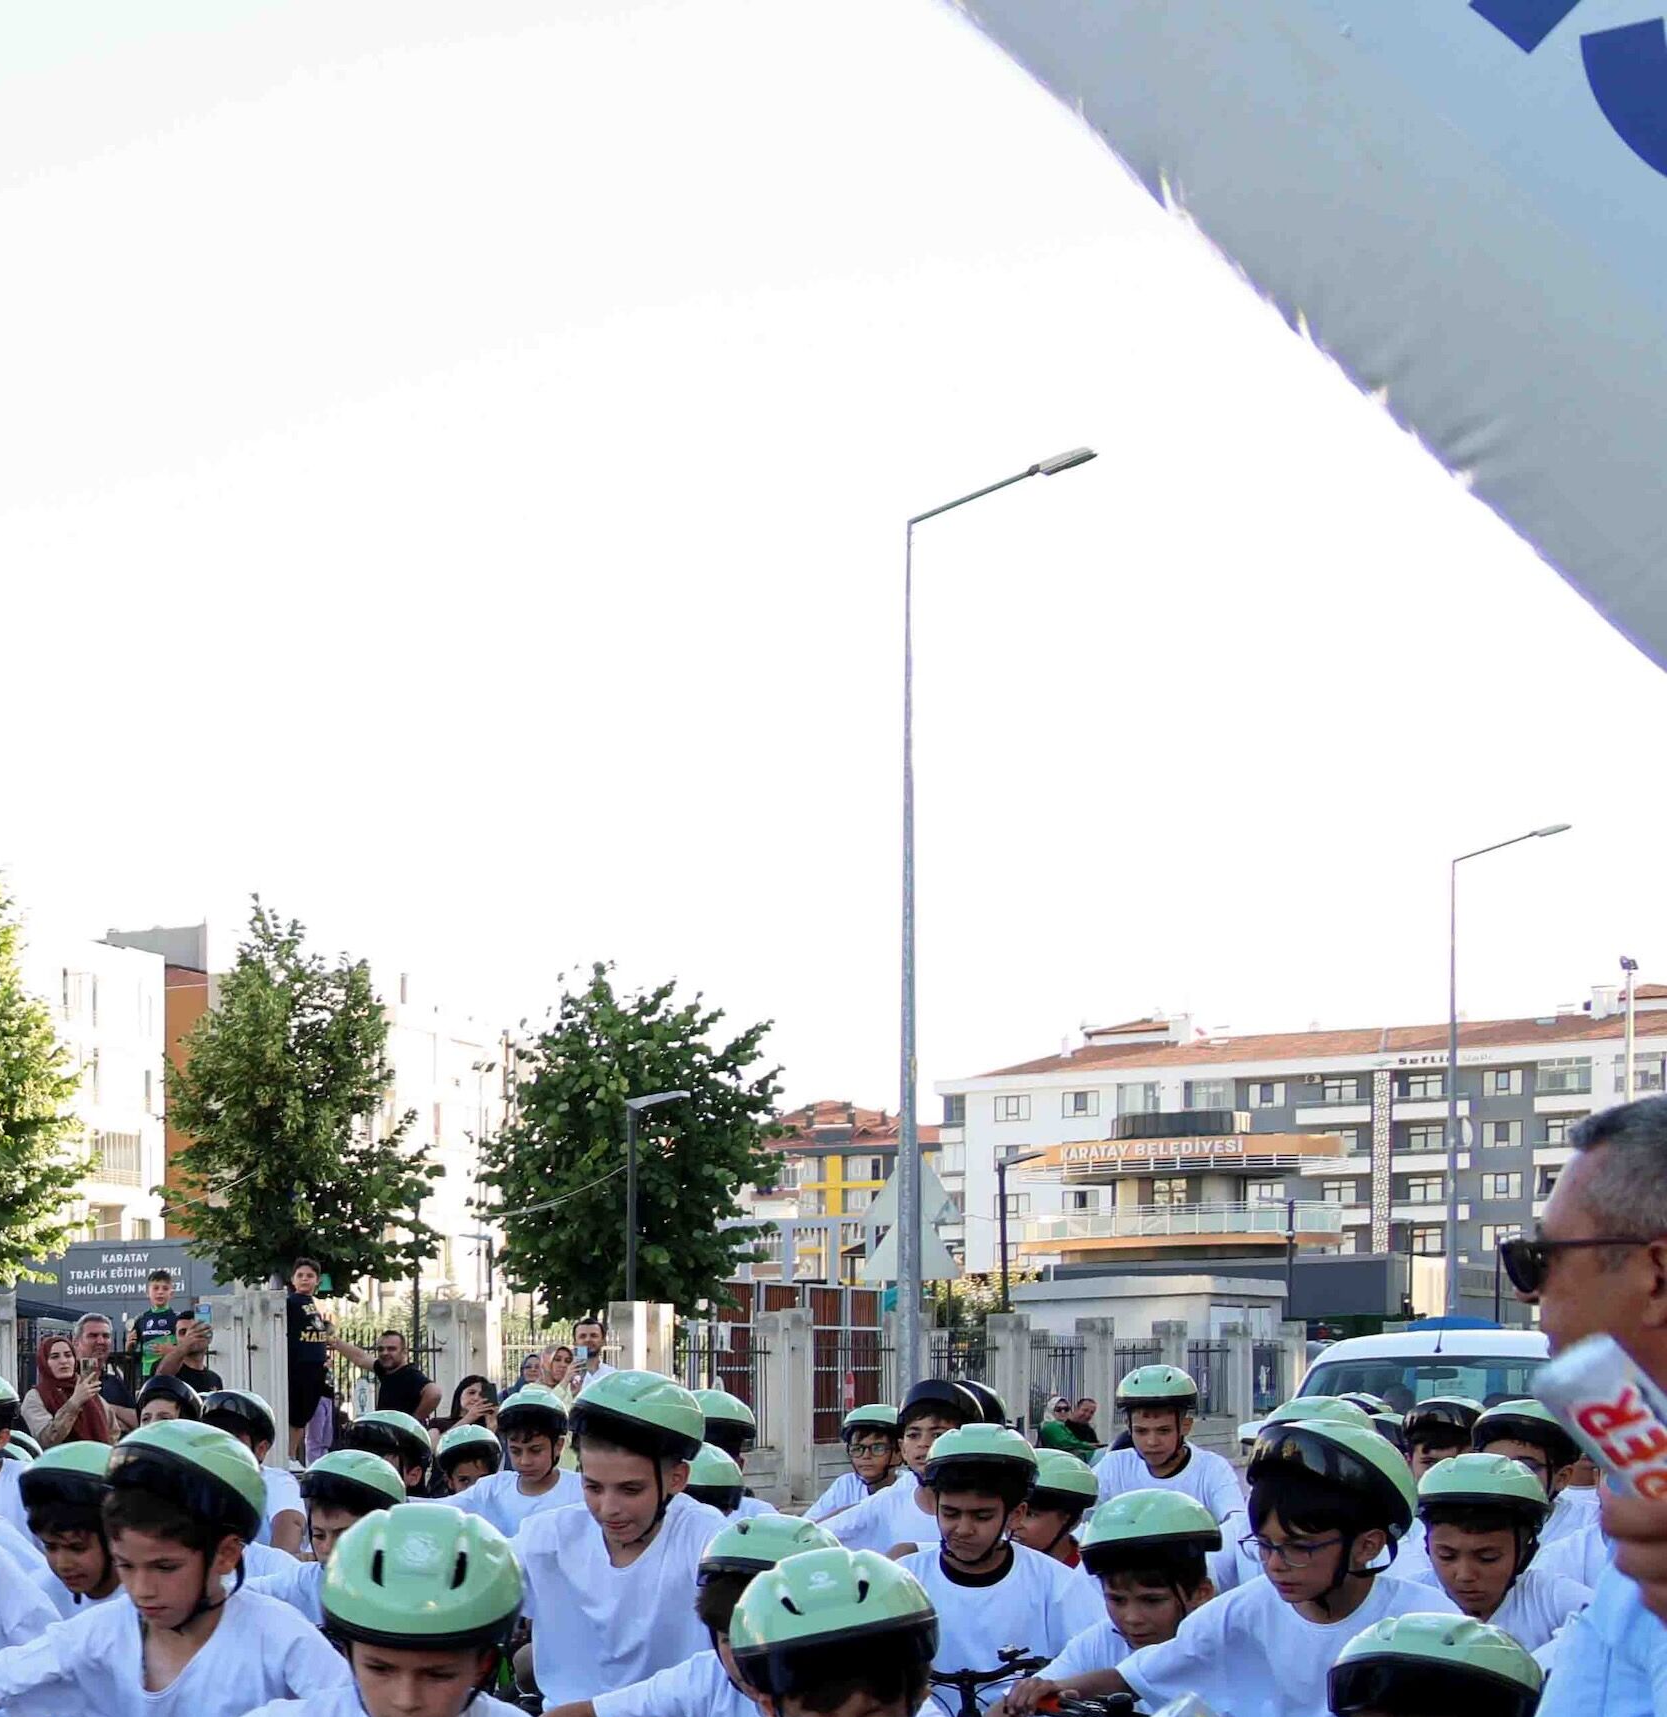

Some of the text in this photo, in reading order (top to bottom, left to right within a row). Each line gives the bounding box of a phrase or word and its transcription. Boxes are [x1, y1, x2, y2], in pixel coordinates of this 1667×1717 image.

[1060, 1135, 1244, 1161] KARATAY BELEDİYESİ
[102, 1252, 149, 1264] KARATAY
[69, 1269, 107, 1280] TRAFİK
[110, 1266, 146, 1279] EĞİTİM
[67, 1282, 136, 1295] SİMÜLASYON
